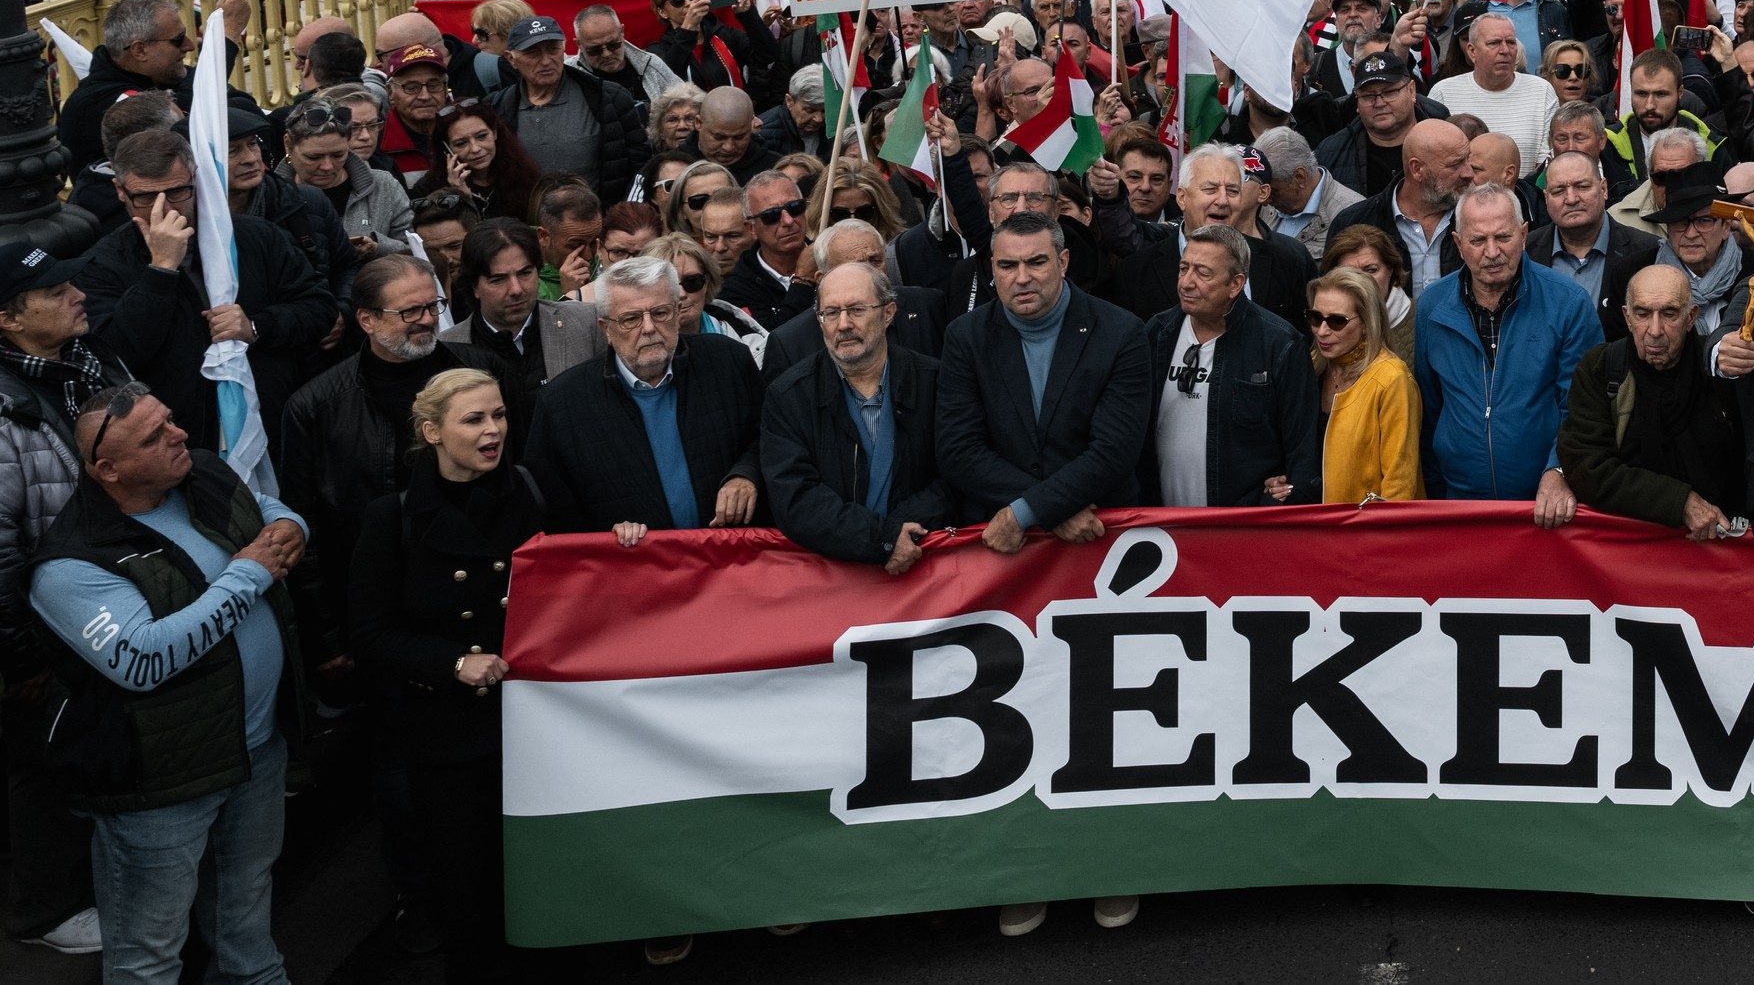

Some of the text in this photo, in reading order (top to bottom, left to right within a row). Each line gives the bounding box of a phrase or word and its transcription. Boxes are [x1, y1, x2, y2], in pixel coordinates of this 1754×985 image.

[529, 26, 547, 35] KENT
[82, 594, 250, 688] HEAVY TOOLS CO.
